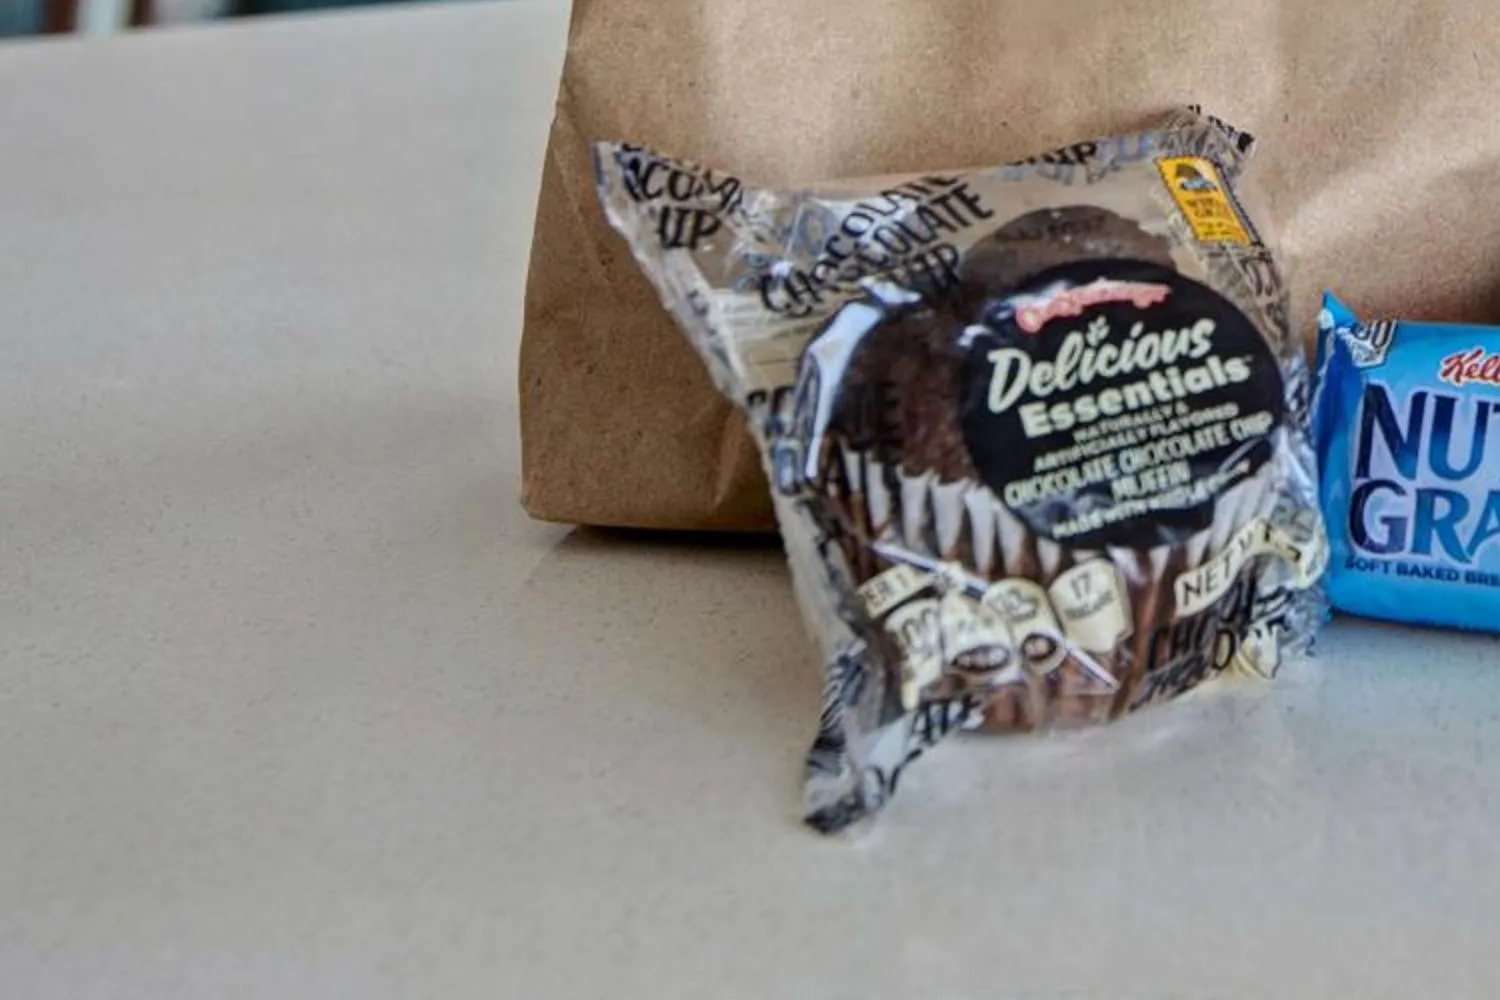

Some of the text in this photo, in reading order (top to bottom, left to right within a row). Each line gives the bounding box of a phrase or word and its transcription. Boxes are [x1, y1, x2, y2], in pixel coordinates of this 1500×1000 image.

[988, 313, 1217, 414] Delicious
[1018, 355, 1250, 439] Essentials
[1003, 410, 1275, 508] CHOCOLATE CHOCOLATE CHIP
[1110, 459, 1192, 502] MUFFIN
[1344, 556, 1391, 573] SOFT
[1396, 562, 1460, 583] BAKED
